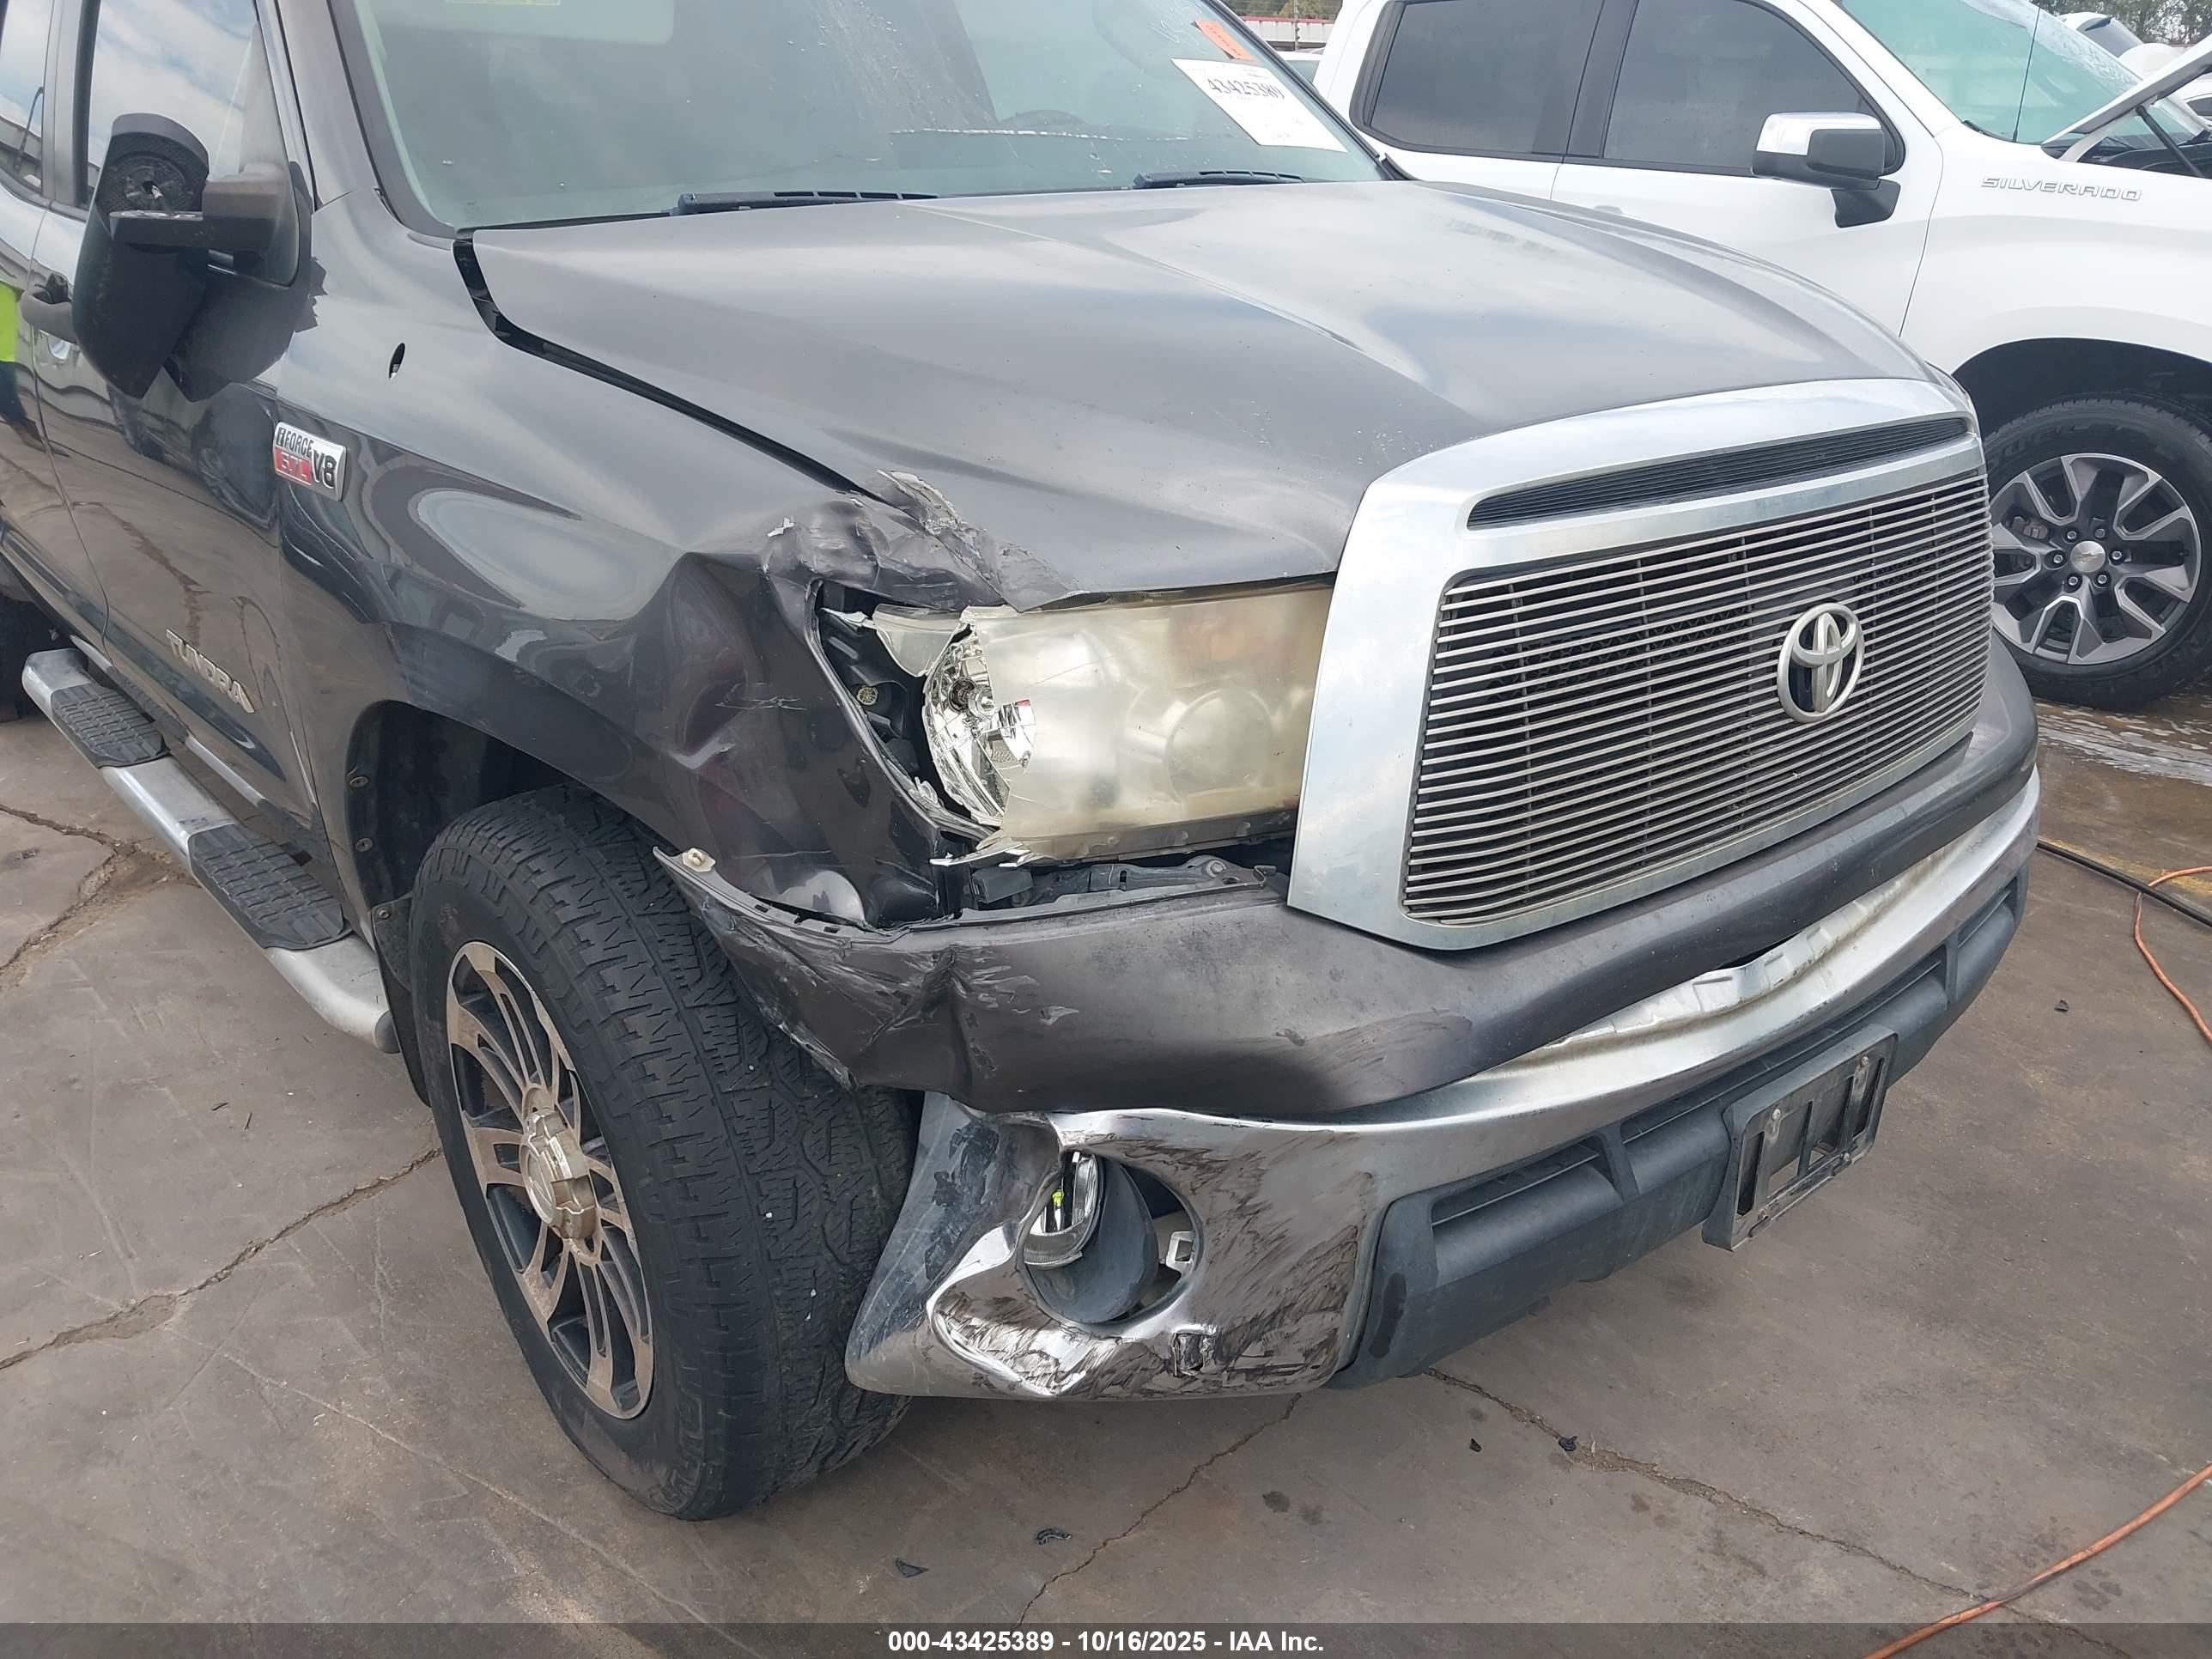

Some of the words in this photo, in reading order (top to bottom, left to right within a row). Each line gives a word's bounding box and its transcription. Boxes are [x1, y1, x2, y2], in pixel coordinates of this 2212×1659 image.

[1981, 177, 2142, 202] SILVERADO
[312, 448, 337, 489] V8
[166, 628, 255, 714] TUNDRA
